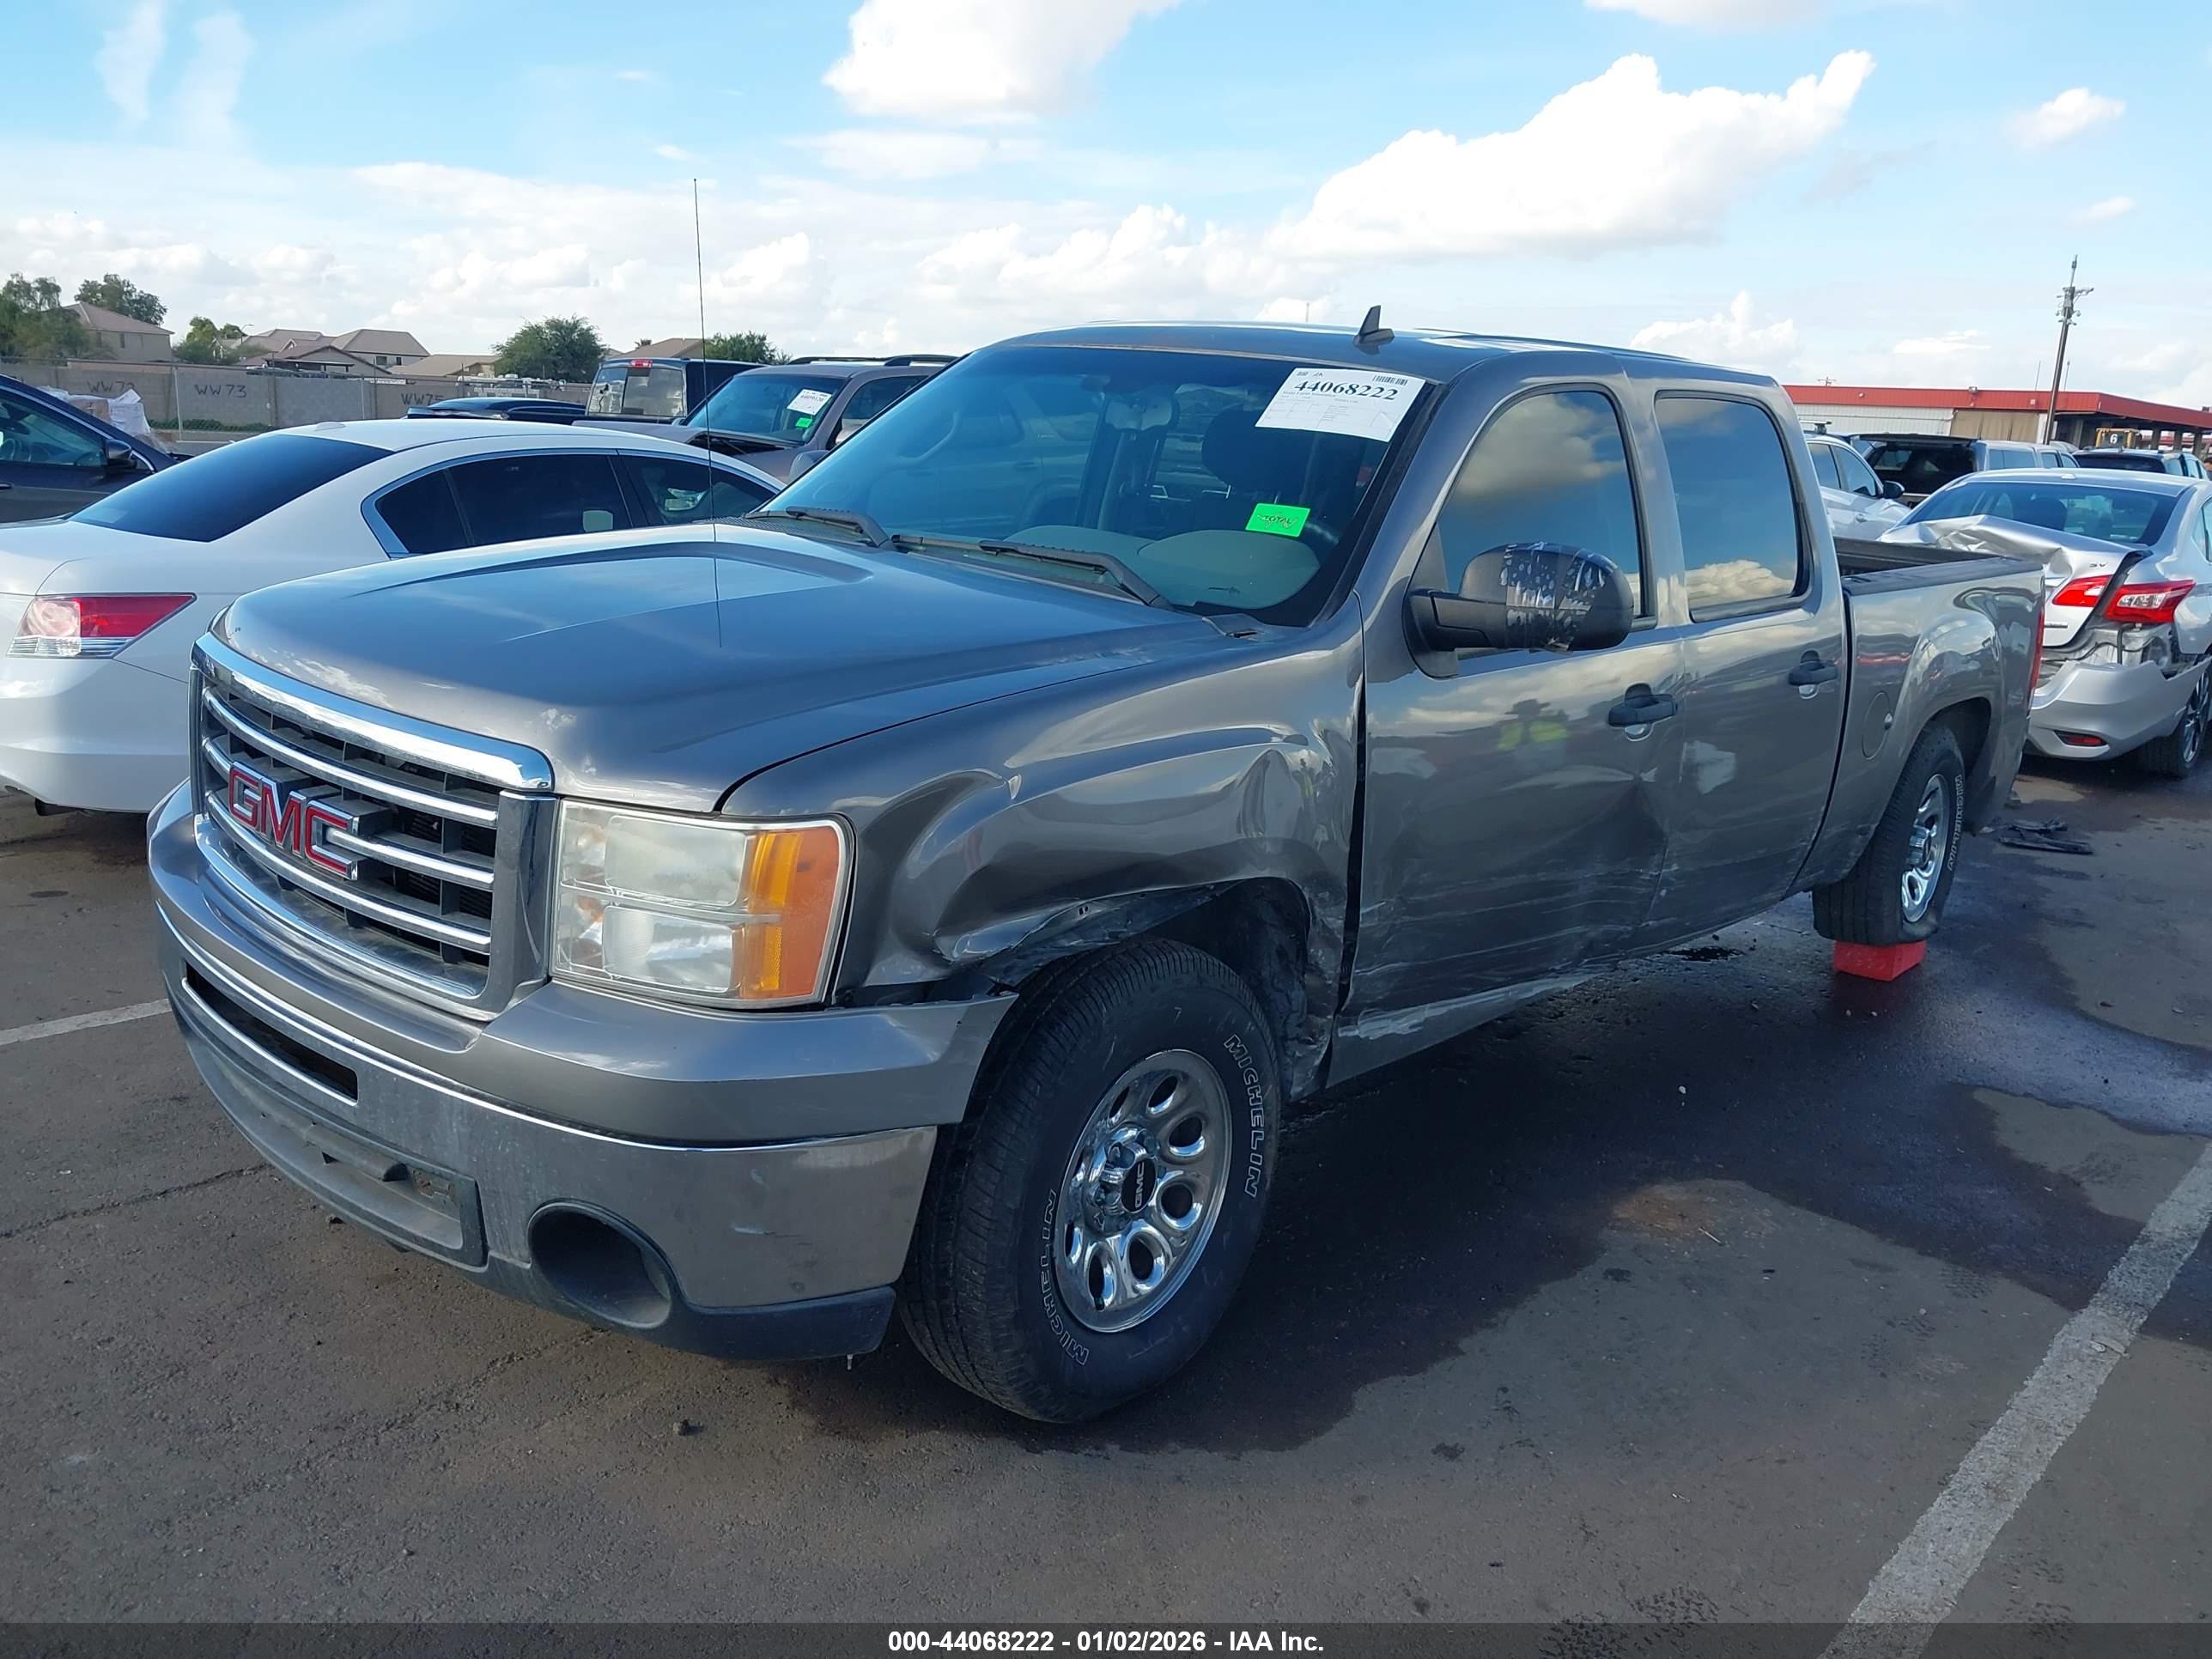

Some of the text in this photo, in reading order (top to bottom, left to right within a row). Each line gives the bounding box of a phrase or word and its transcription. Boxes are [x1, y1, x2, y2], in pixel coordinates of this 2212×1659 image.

[226, 384, 247, 398] 73
[1294, 380, 1399, 401] 44068222
[2110, 433, 2118, 444] 6
[228, 761, 358, 881] GMC
[1224, 1033, 1265, 1198] MICHELIN
[1134, 1161, 1146, 1209] GMC
[1040, 1188, 1090, 1366] MICHELIN
